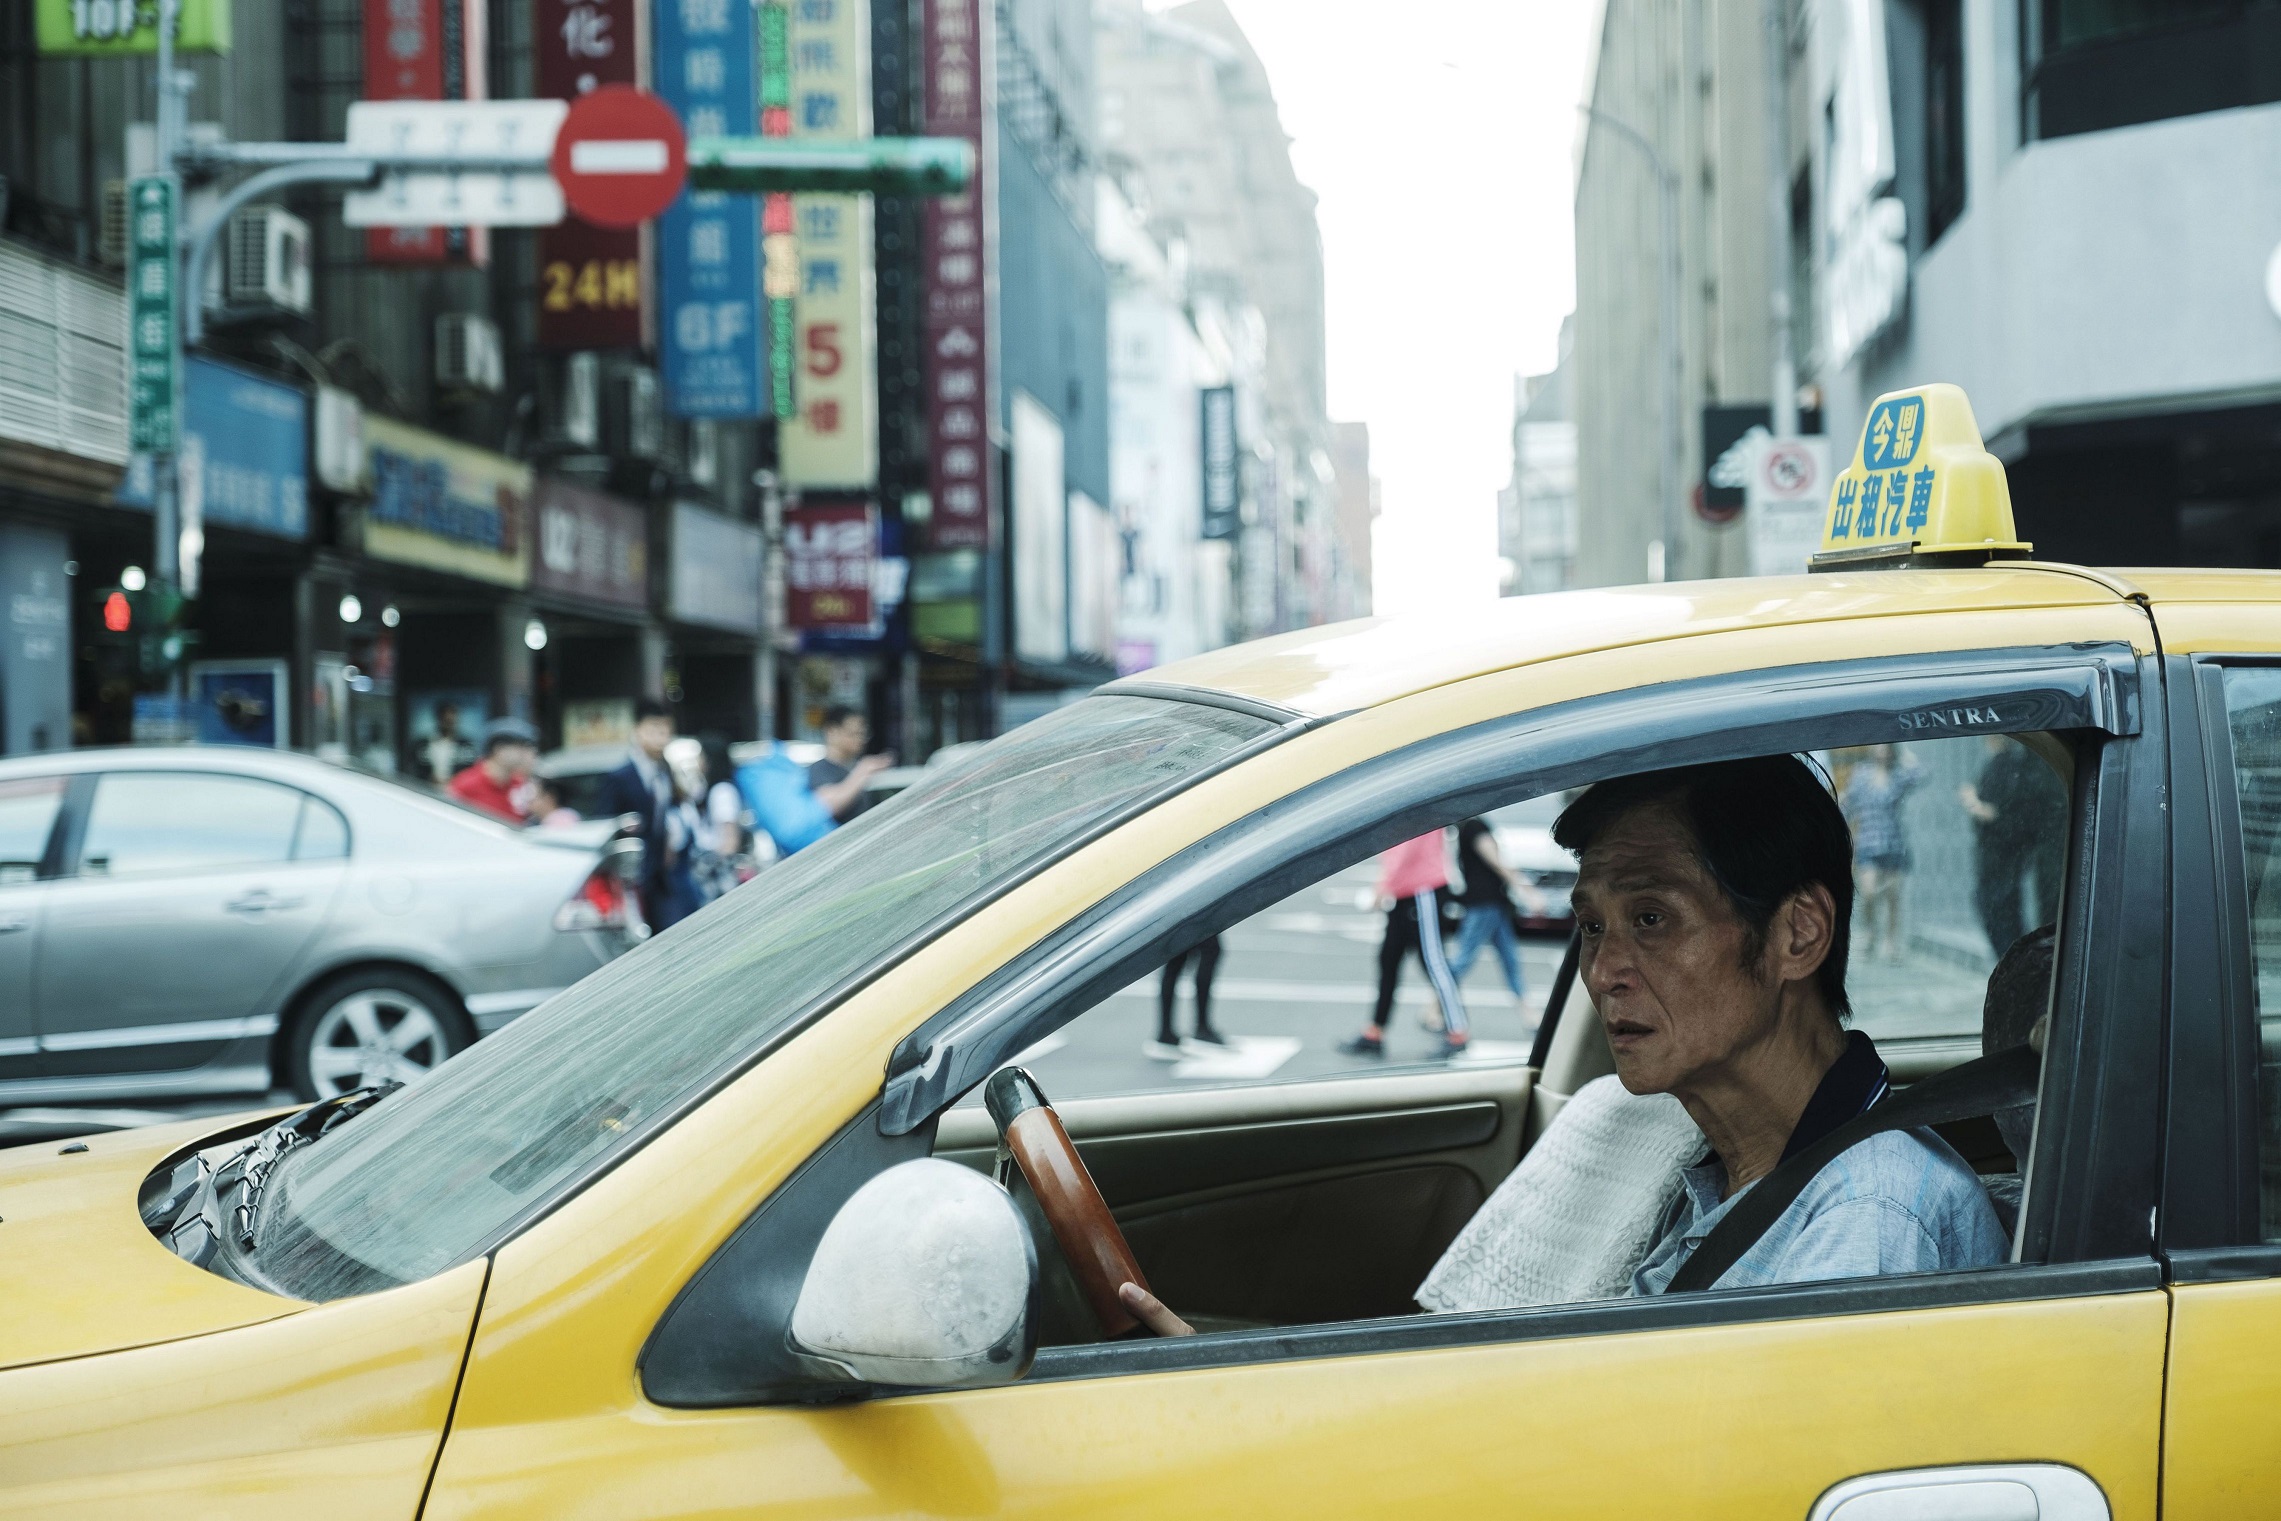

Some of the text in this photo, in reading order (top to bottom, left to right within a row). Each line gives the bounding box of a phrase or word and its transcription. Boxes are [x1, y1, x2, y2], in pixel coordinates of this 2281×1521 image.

[544, 260, 641, 312] 24H
[1872, 403, 1920, 463] 今鼎
[1831, 464, 1936, 541] 出租汽車
[1898, 706, 2001, 730] SENTRA
